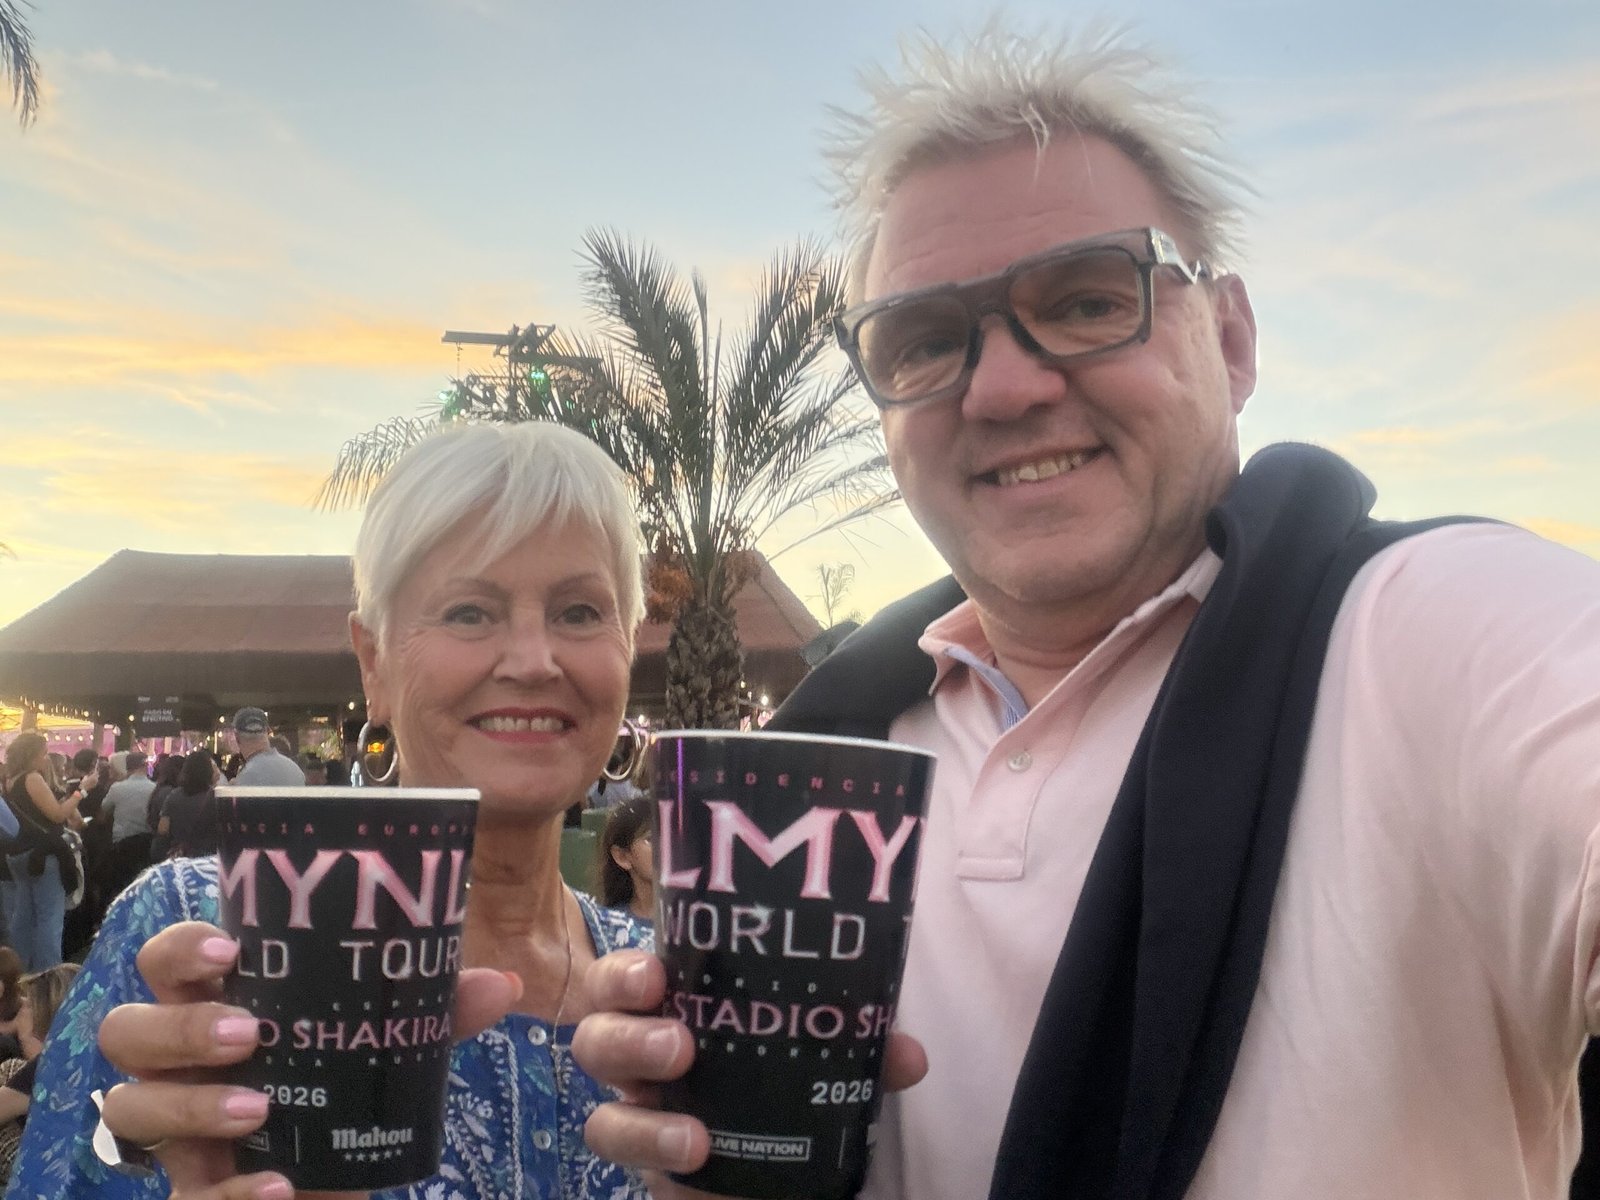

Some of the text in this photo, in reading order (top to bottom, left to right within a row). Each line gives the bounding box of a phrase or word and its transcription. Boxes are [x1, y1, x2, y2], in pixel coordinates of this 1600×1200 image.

[658, 799, 923, 903] LMY
[338, 935, 461, 981] TOUR
[293, 1012, 452, 1050] SHAKIRA
[673, 992, 845, 1039] STADIO
[810, 1078, 875, 1105] 2026
[331, 1126, 414, 1150] Mahou
[741, 1141, 804, 1156] NATION
